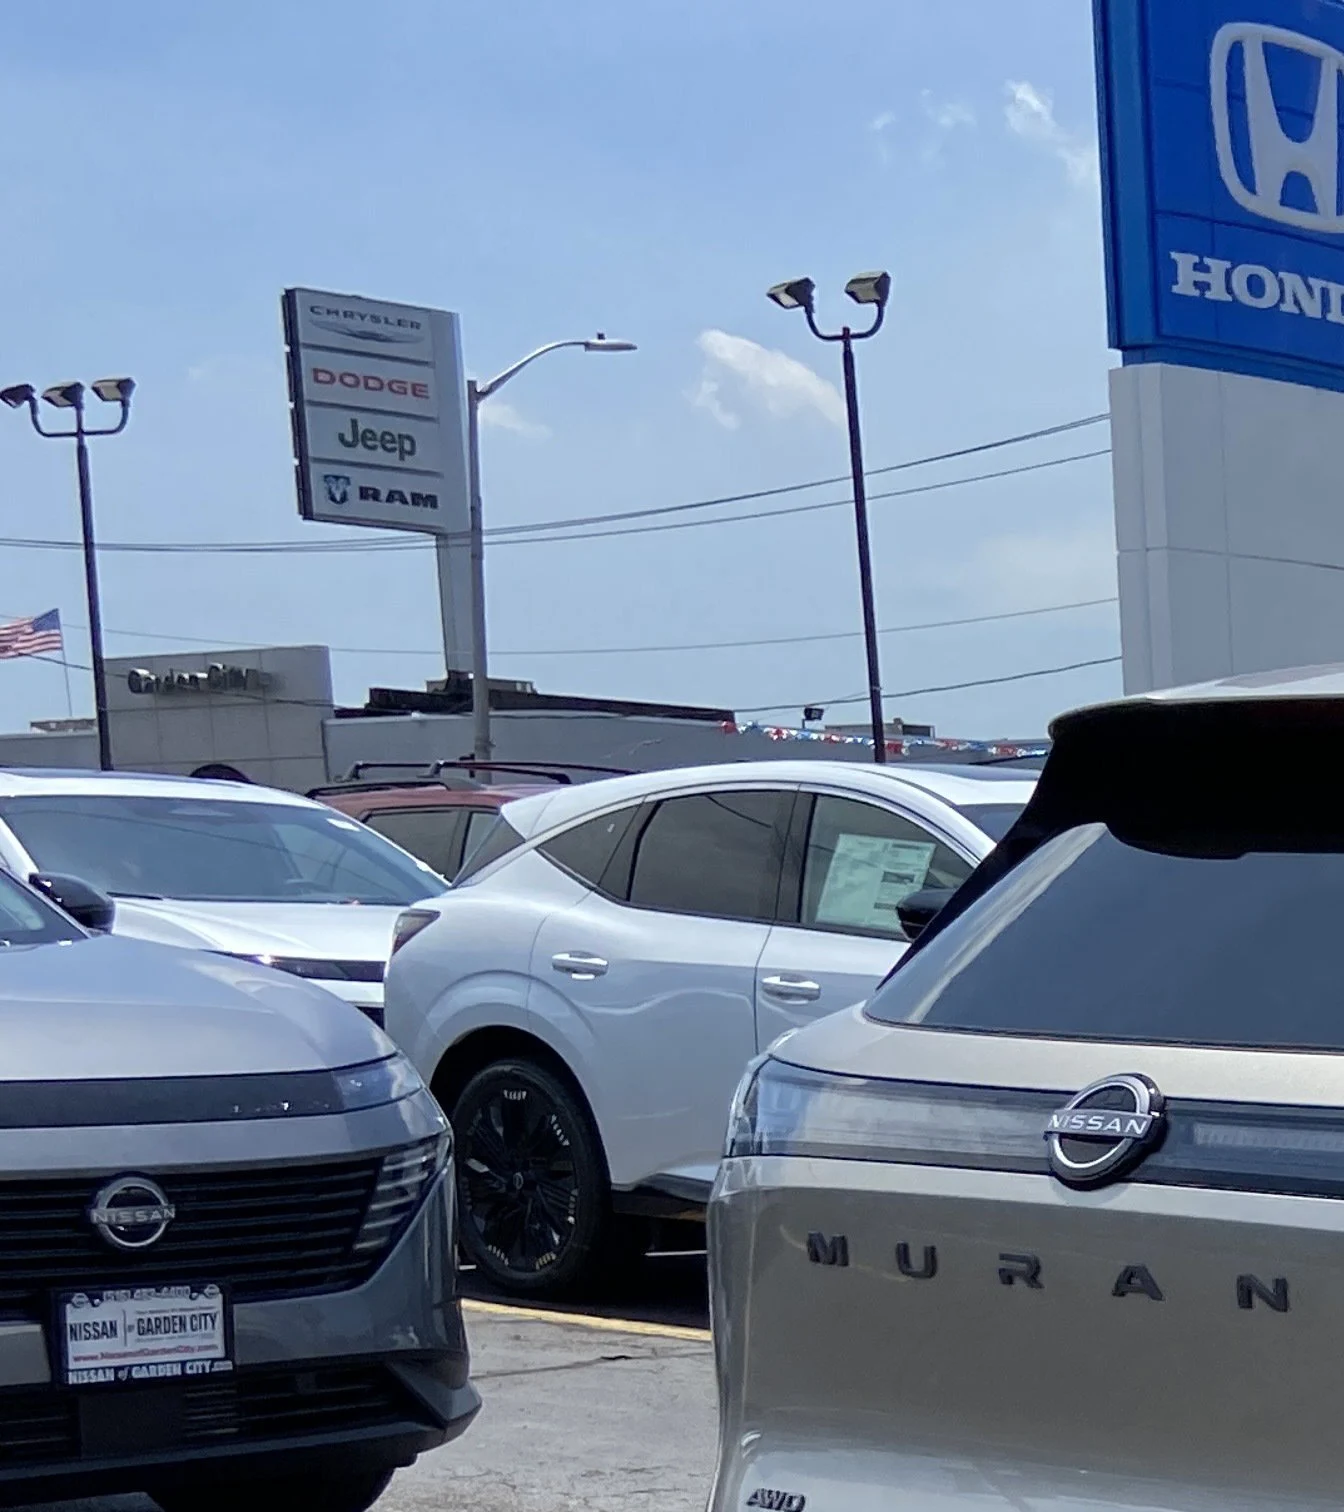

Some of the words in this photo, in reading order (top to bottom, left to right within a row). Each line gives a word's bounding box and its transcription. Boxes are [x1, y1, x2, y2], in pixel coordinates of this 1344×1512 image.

[309, 305, 422, 330] CHRYSLER
[312, 367, 431, 400] DODGE
[337, 418, 417, 461] Jeep
[358, 485, 439, 509] RAM
[1047, 1114, 1148, 1135] NISSAN
[91, 1206, 175, 1223] NISSAN
[69, 1320, 118, 1342] NISSAN
[137, 1315, 188, 1336] GARDEN
[190, 1312, 218, 1332] CITY
[68, 1368, 115, 1384] NISSAN
[131, 1363, 182, 1379] GARDEN
[746, 1487, 806, 1512] AWD
